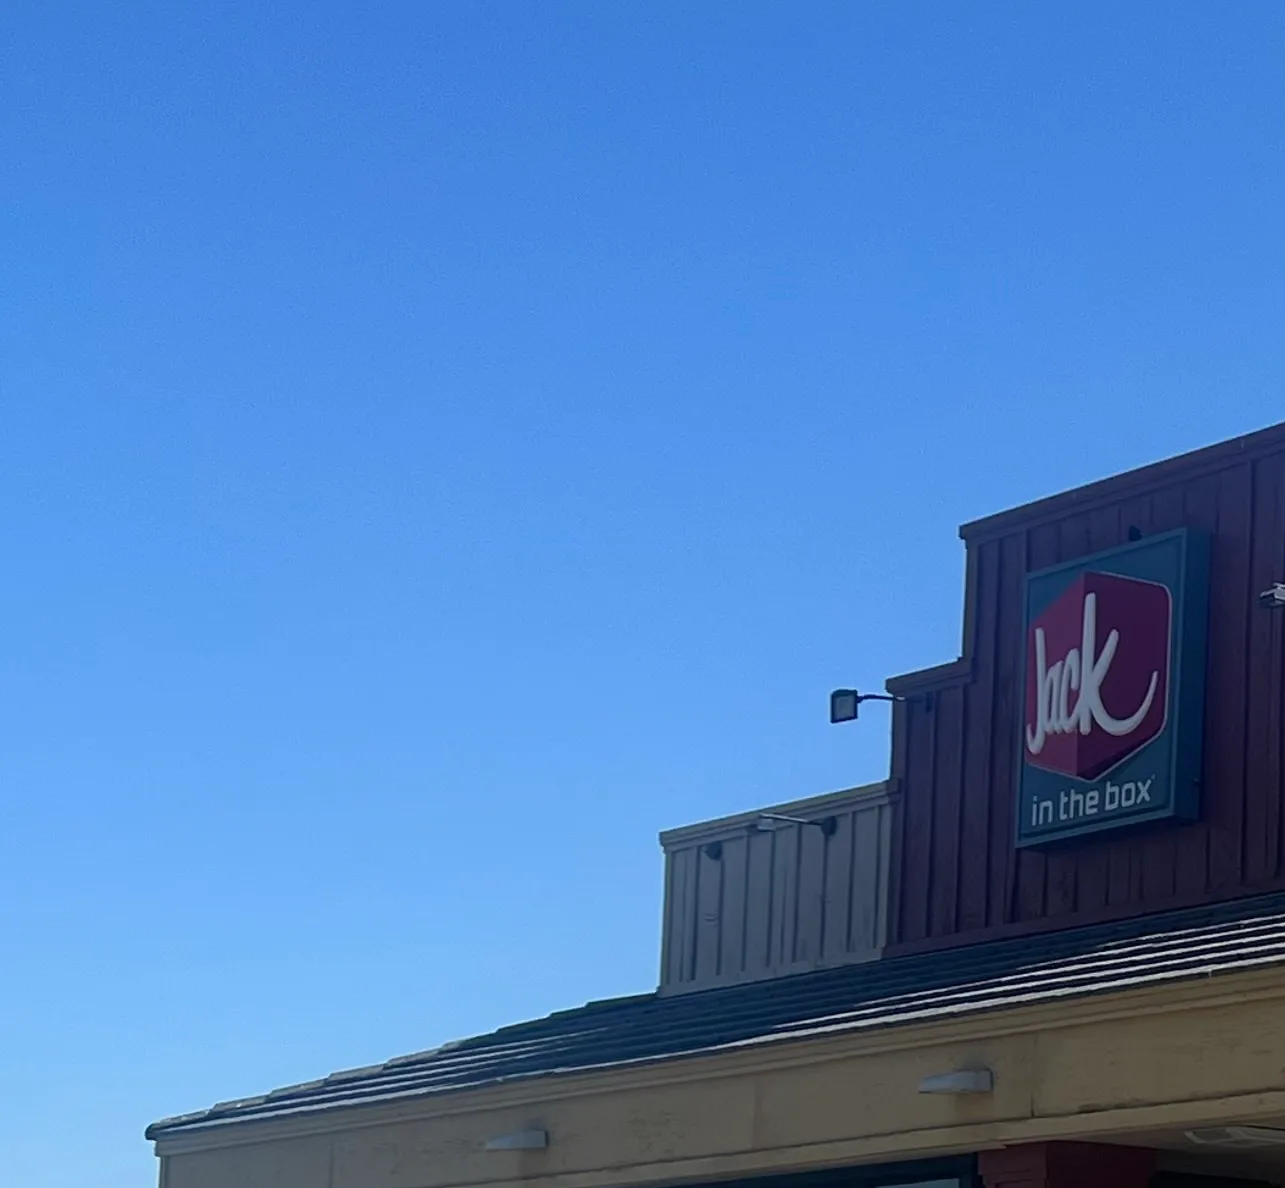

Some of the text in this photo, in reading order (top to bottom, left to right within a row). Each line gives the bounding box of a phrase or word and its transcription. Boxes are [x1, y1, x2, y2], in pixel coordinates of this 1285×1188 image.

[1026, 591, 1158, 755] Jack
[1030, 777, 1151, 826] in the box
